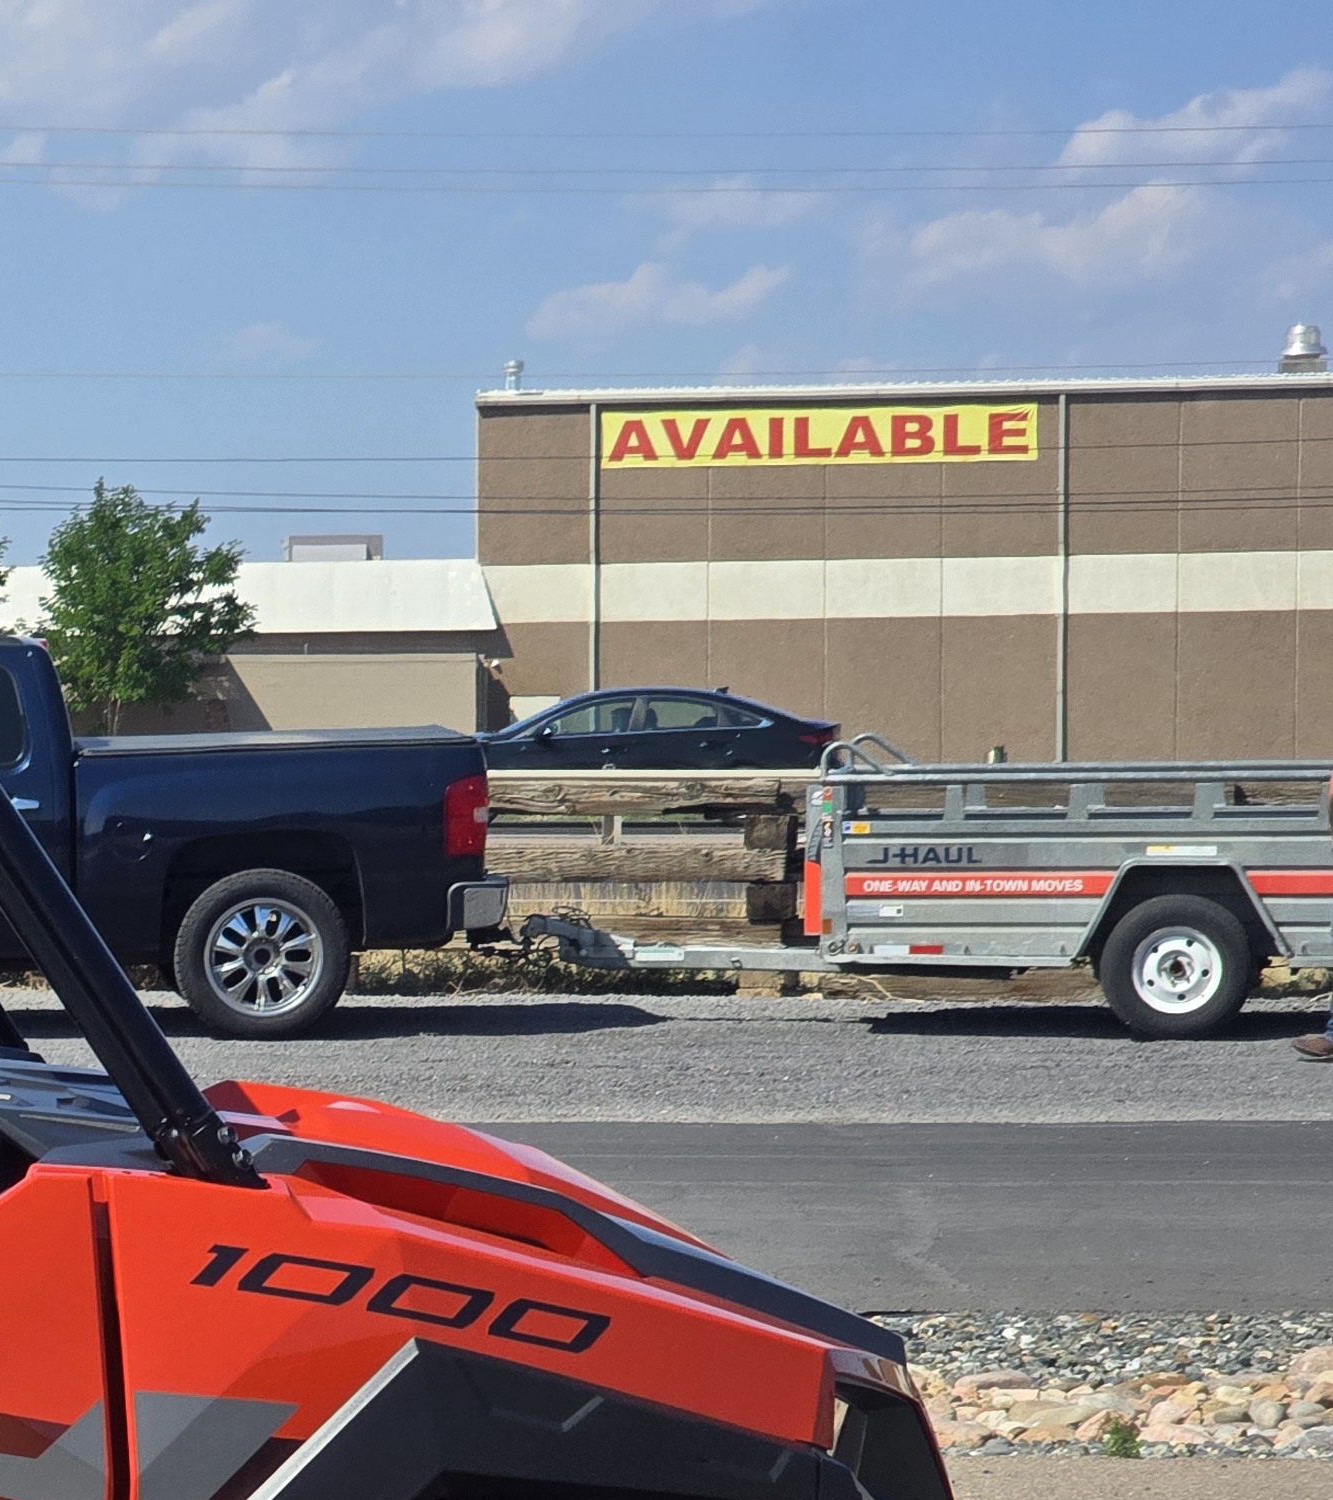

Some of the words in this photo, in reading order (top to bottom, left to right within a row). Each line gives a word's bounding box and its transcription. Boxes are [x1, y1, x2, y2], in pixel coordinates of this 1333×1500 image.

[608, 412, 1031, 462] AVAILABLE
[863, 879, 928, 893] ONE-WAY
[931, 879, 963, 893] AND
[965, 878, 1029, 893] IN-TOWN
[1031, 878, 1084, 892] MOVES
[190, 1244, 611, 1353] 1000
